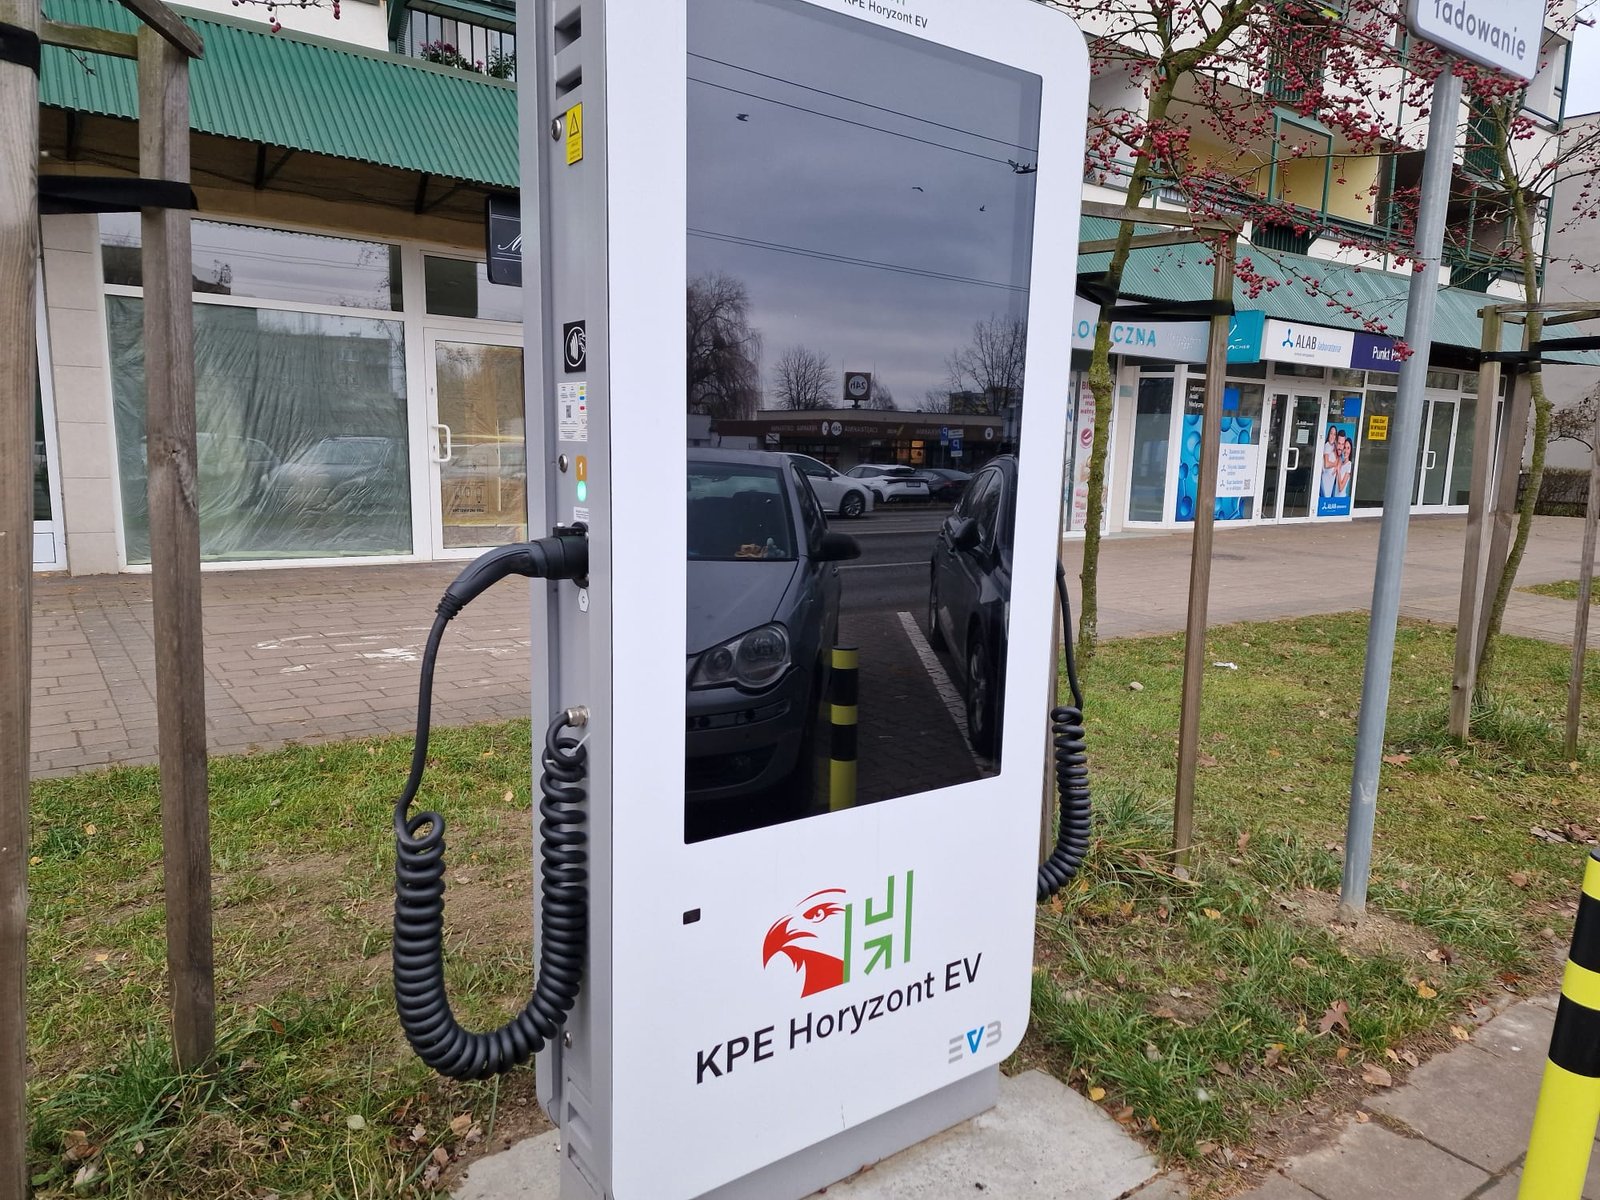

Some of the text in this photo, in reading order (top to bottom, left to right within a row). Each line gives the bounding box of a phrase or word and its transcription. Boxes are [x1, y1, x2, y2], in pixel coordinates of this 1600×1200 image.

[869, 0, 912, 24] Horyzont
[915, 15, 928, 28] EV
[1072, 320, 1156, 347] OCZNA
[1295, 334, 1318, 350] ALAB
[1372, 346, 1390, 360] Punkt
[578, 462, 584, 476] 1
[696, 952, 982, 1084] KPE Horyzont EV
